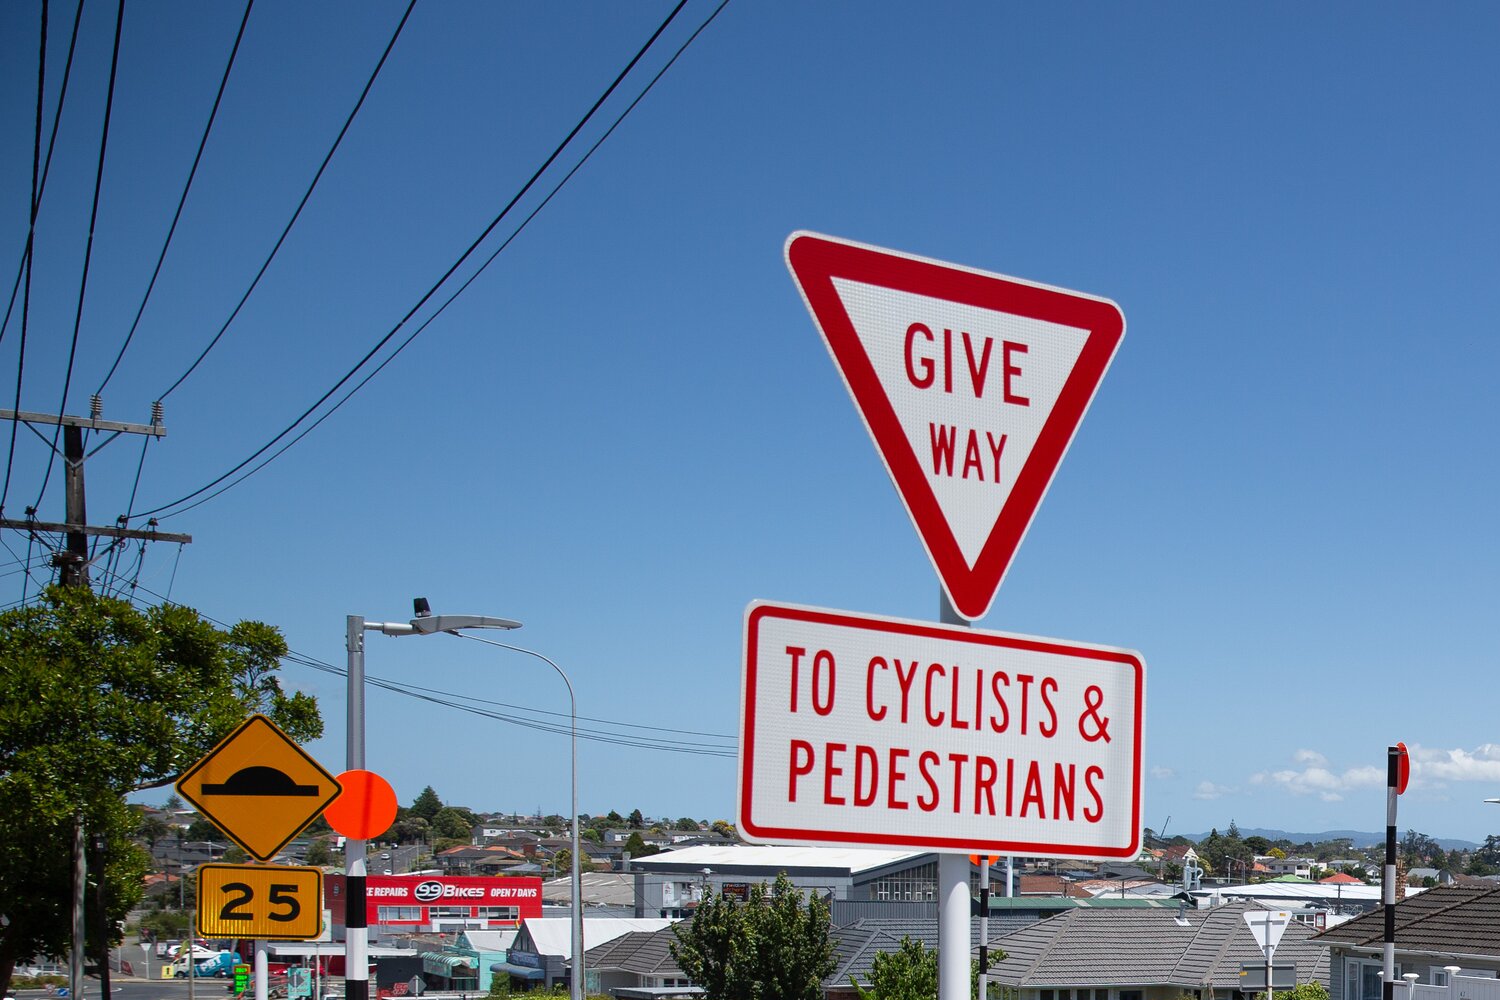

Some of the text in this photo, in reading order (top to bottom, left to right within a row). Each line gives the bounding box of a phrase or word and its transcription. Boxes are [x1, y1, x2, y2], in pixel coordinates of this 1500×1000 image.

[903, 322, 1031, 407] GIVE
[929, 422, 1008, 484] WAY
[785, 645, 1112, 744] TO CYCLISTS &
[788, 738, 1106, 825] PEDESTRIANS
[219, 882, 301, 921] 25
[374, 887, 408, 897] REPAIRS
[417, 884, 442, 897] 99
[490, 888, 511, 897] OPEN
[511, 888, 518, 897] 7
[517, 888, 538, 897] DAYS
[200, 955, 221, 971] PBT
